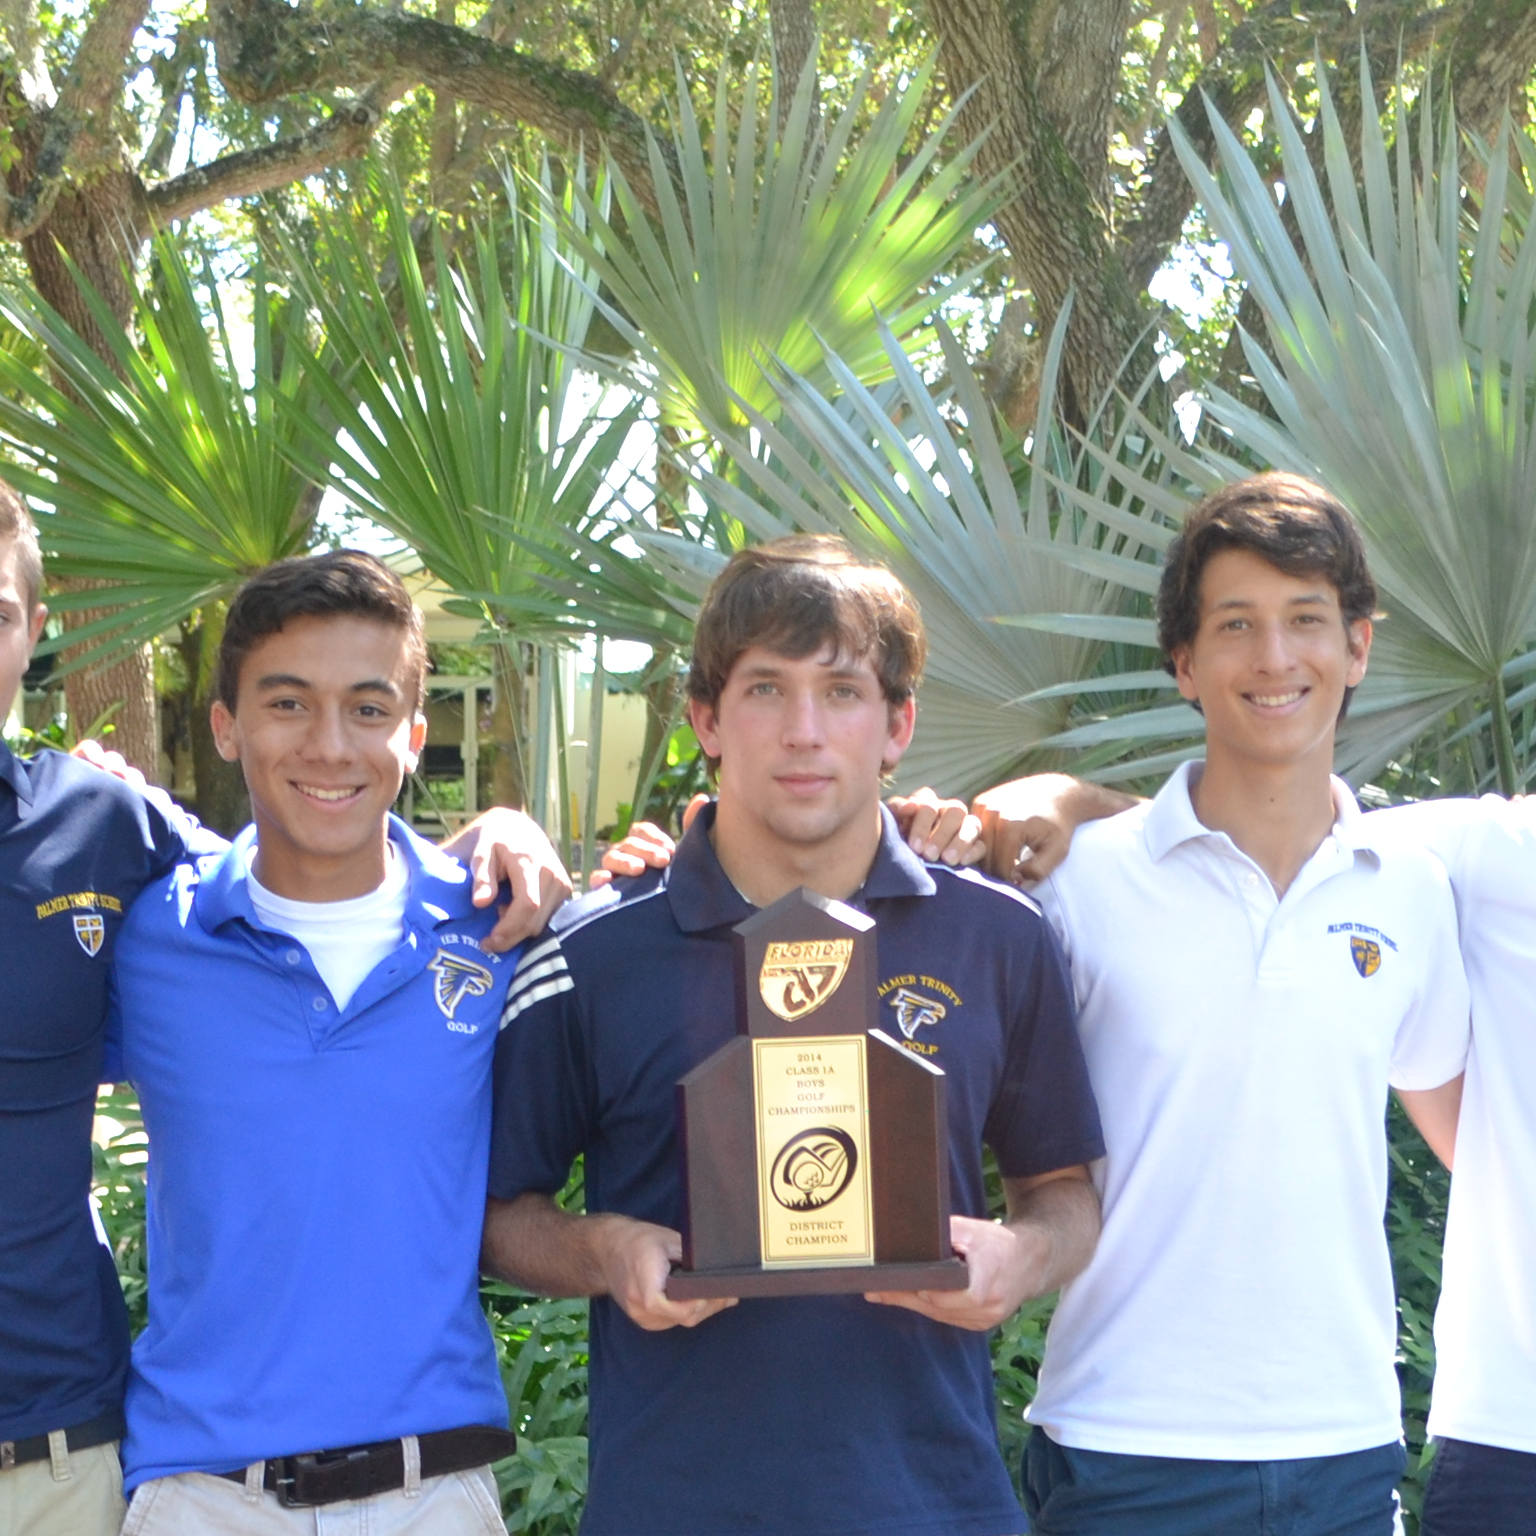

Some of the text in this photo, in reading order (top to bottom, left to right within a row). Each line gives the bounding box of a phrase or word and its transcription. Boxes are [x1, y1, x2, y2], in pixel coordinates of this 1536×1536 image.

[769, 940, 846, 959] FLORIDA
[876, 974, 963, 1007] ALMER TRINITY
[446, 1020, 478, 1035] GOLF
[797, 1053, 823, 1063] 2014
[785, 1066, 820, 1076] CLASS
[796, 1079, 825, 1089] BOYS
[797, 1093, 825, 1102] GOLF
[767, 1104, 856, 1116] CHAMPIONSHIPS
[789, 1220, 844, 1231] DISTRICT
[786, 1234, 848, 1246] CHAMPION
